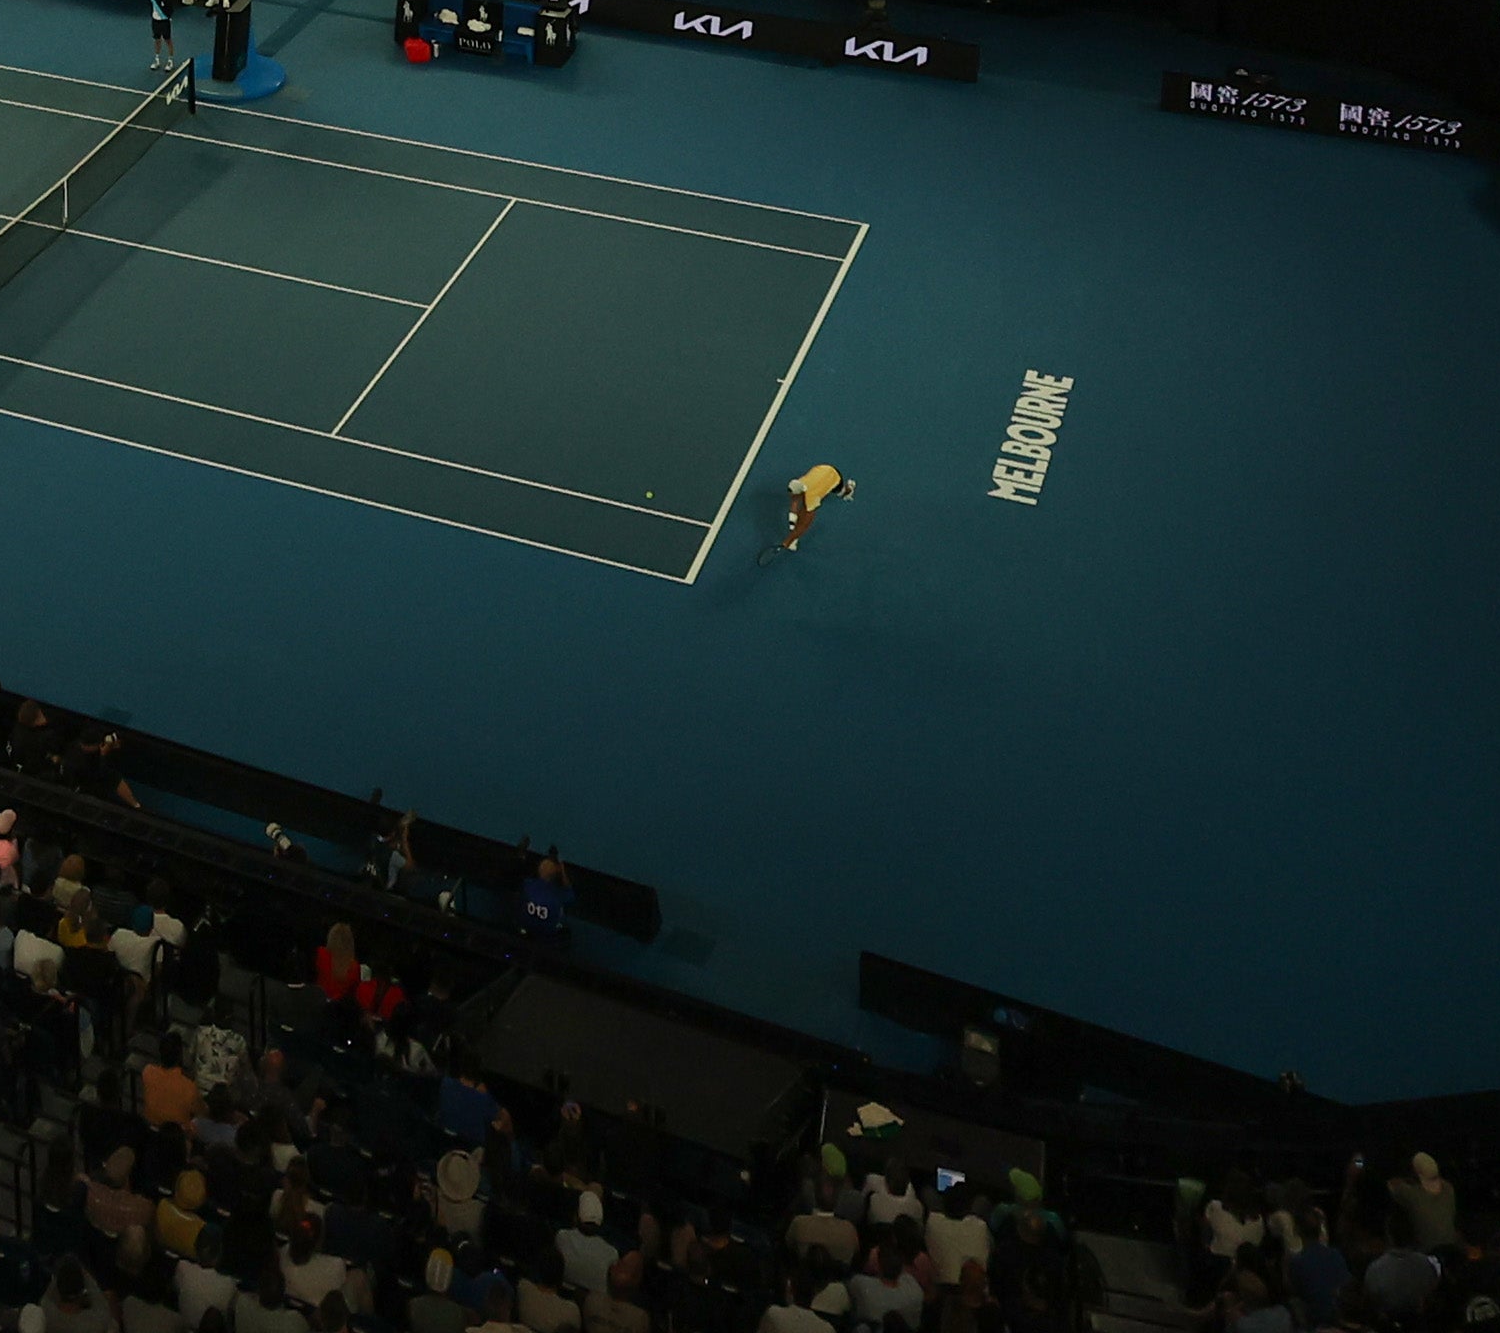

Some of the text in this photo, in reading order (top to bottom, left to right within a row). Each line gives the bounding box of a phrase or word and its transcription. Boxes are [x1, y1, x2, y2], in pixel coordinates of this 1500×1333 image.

[458, 37, 492, 50] POLO
[674, 12, 927, 65] KIA KIA
[988, 370, 1073, 504] MELBOURNE
[527, 901, 549, 920] 013
